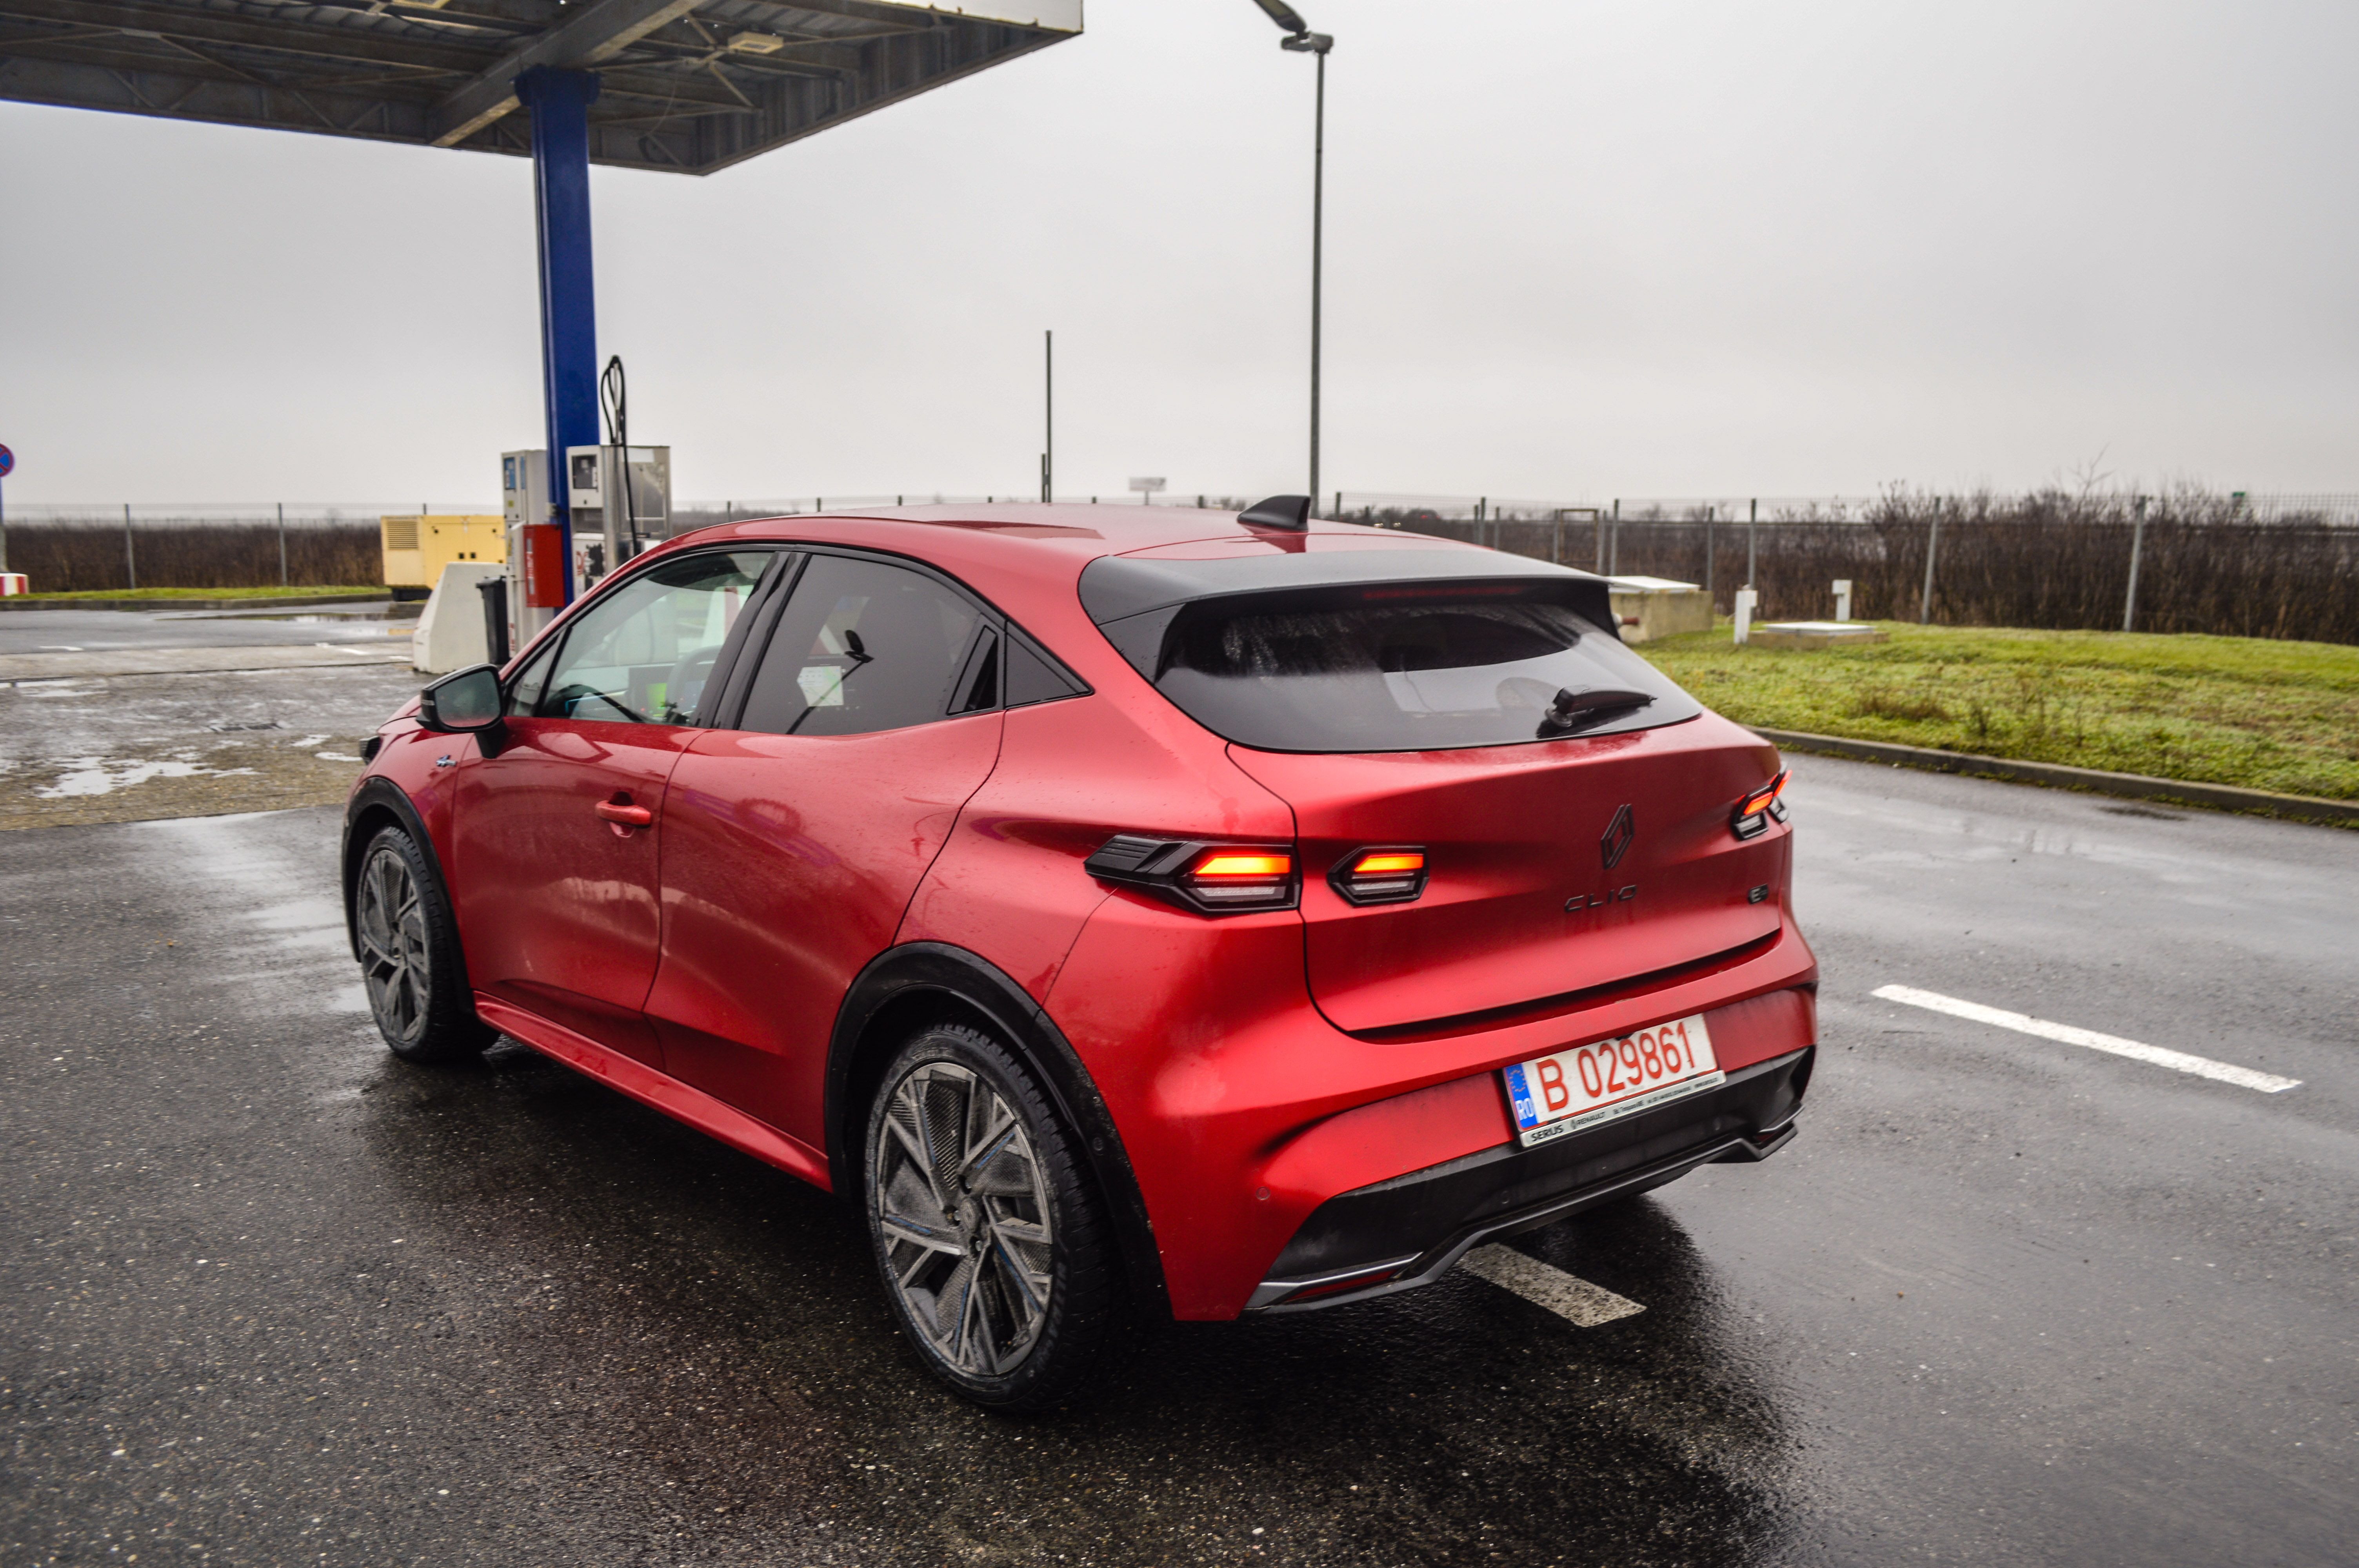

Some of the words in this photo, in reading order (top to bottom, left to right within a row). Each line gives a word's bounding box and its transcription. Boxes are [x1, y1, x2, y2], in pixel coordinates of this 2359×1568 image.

[1565, 885, 1637, 911] CLIO
[1536, 1059, 1569, 1112] B
[1578, 1022, 1694, 1098] 029861
[1515, 1098, 1535, 1120] RO
[1576, 1111, 1606, 1125] RENAULT
